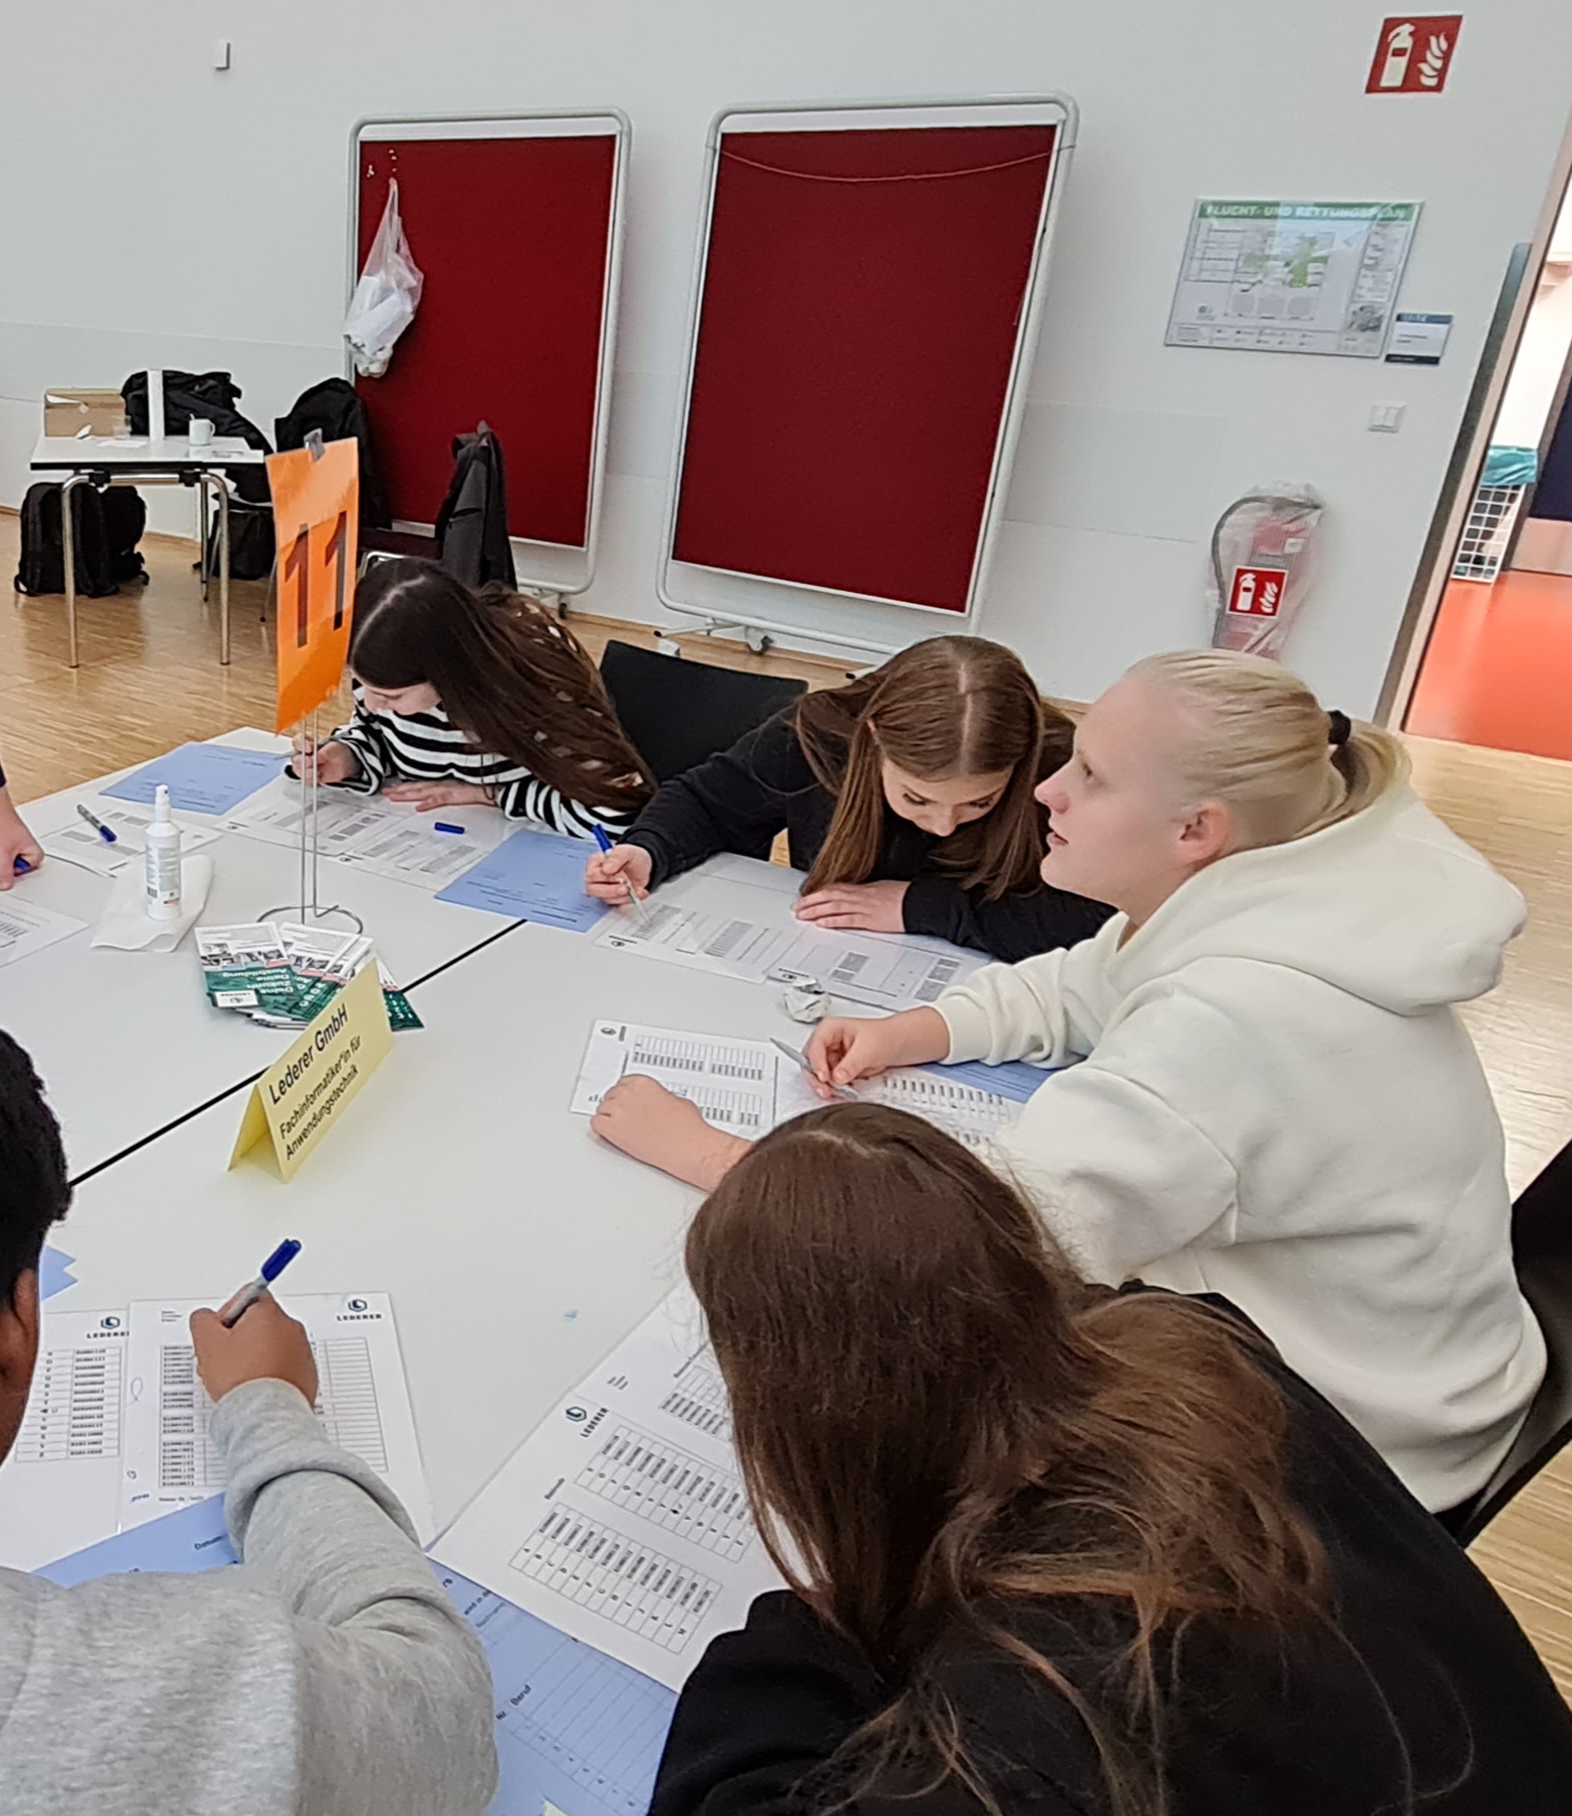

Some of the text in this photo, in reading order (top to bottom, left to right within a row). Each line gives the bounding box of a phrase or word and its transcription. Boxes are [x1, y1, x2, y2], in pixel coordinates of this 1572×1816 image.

[1264, 205, 1292, 218] UND
[284, 510, 348, 649] 11
[269, 1045, 315, 1105] Lederer
[314, 1003, 349, 1052] GmbH
[349, 1034, 361, 1055] für
[286, 1063, 360, 1161] Anwendungstechnik
[336, 1313, 382, 1322] LEDERER
[579, 1407, 610, 1438] LEDERER
